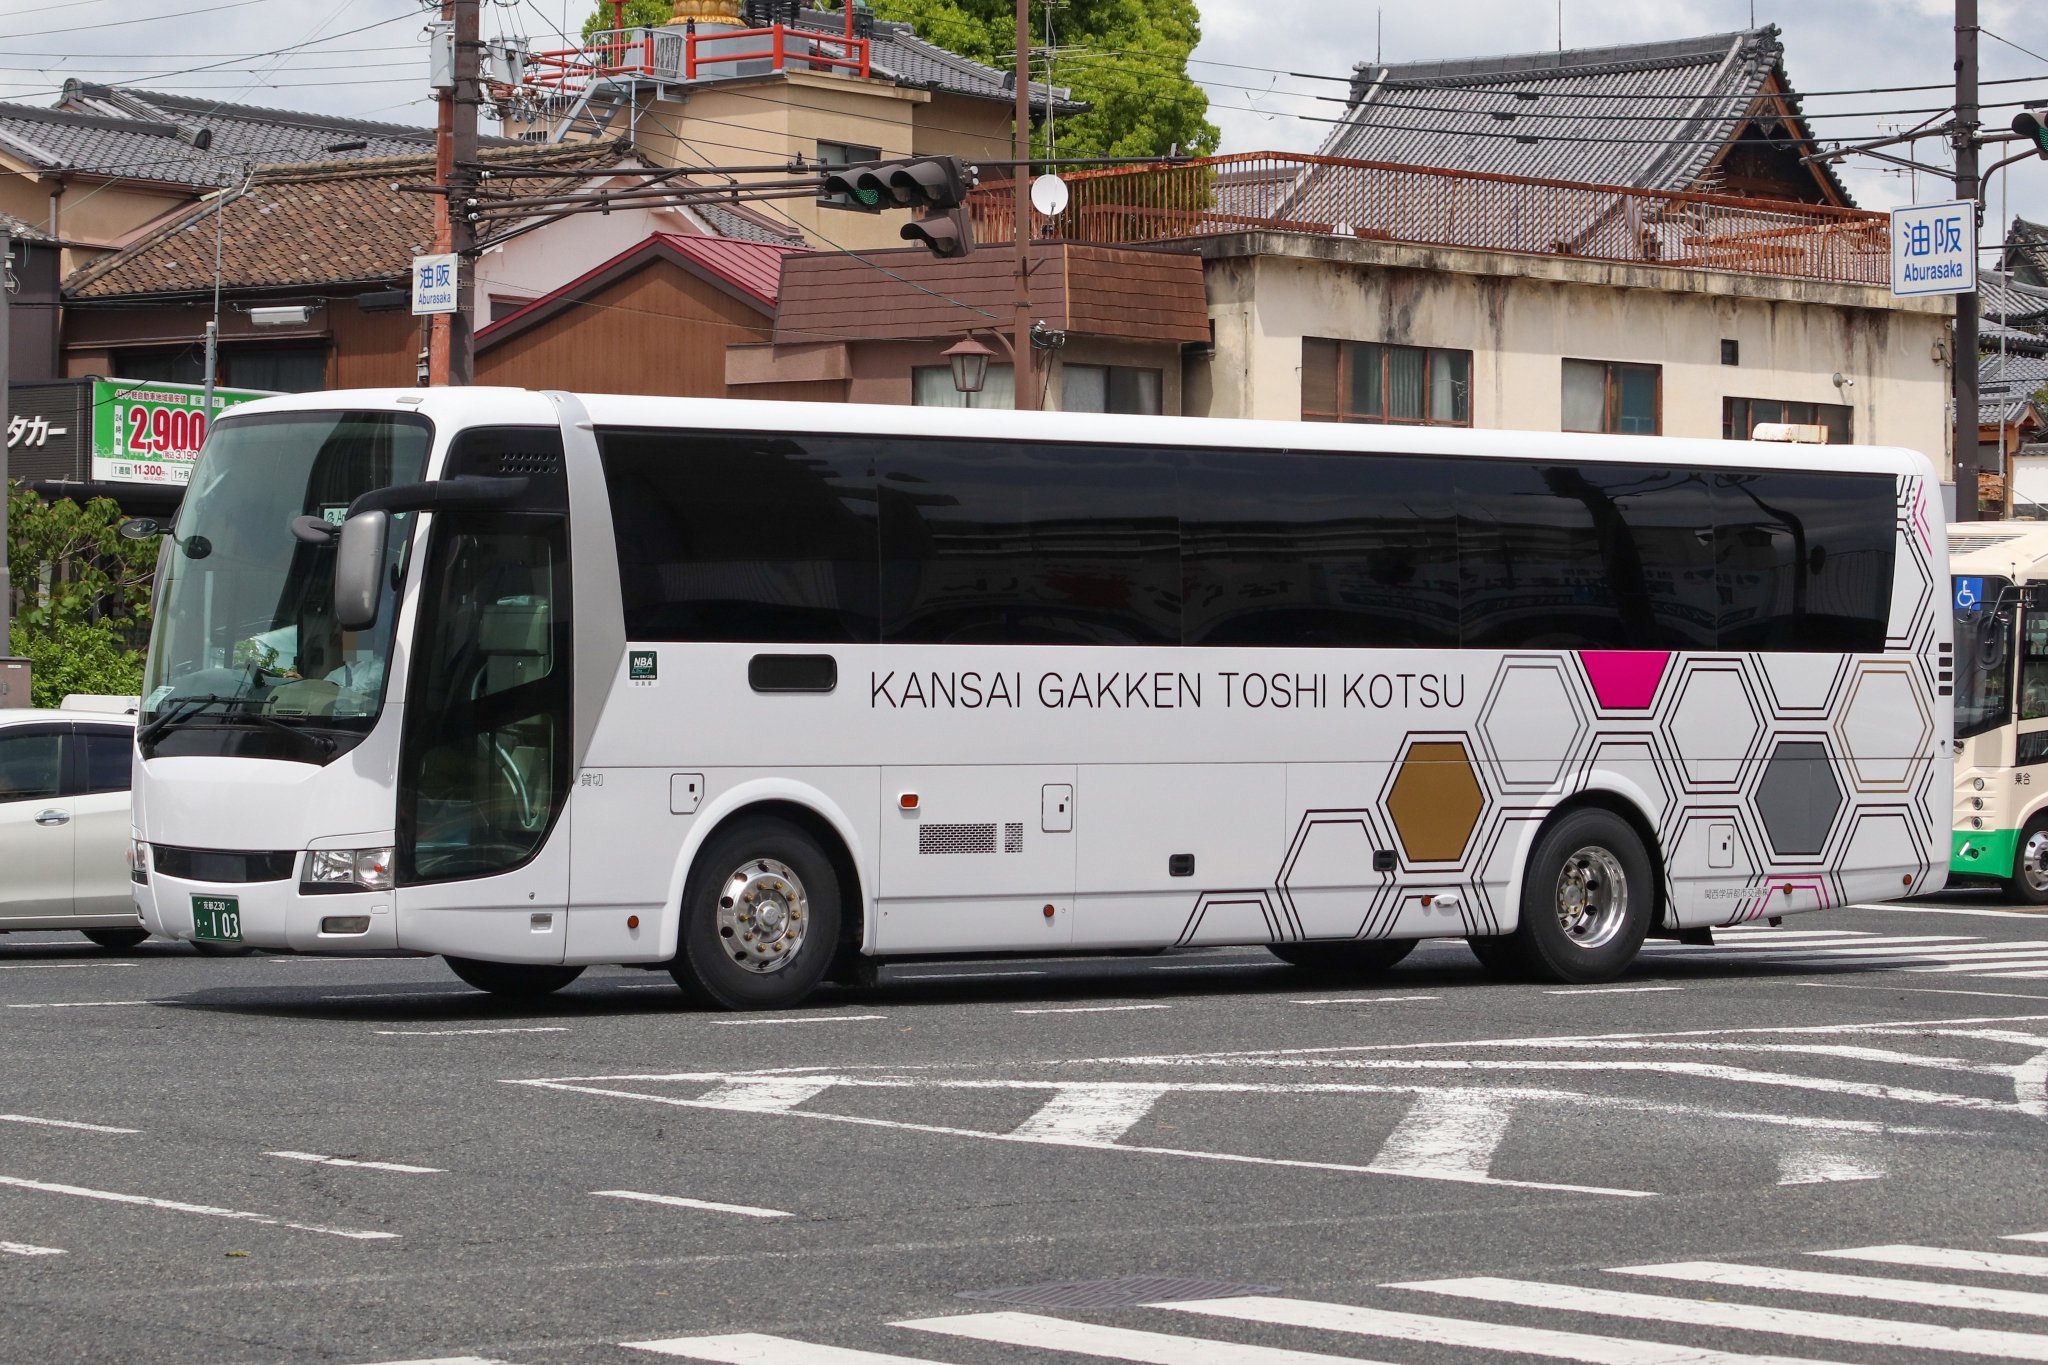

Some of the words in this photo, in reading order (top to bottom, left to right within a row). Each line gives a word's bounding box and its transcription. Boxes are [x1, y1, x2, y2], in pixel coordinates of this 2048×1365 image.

[1904, 217, 1962, 257] 油阪
[420, 264, 450, 289] 油阪
[1904, 260, 1962, 282] Aburasaka
[419, 292, 450, 304] Aburasaka
[130, 407, 205, 454] 2,900
[633, 657, 653, 667] NBA
[871, 671, 1021, 708] KANSAI
[1038, 671, 1201, 708] GAKKEN
[1218, 672, 1327, 708] TOSHI
[1343, 673, 1466, 708] KOTSU
[581, 773, 604, 786] 貸切
[2015, 772, 2031, 785] 乗合
